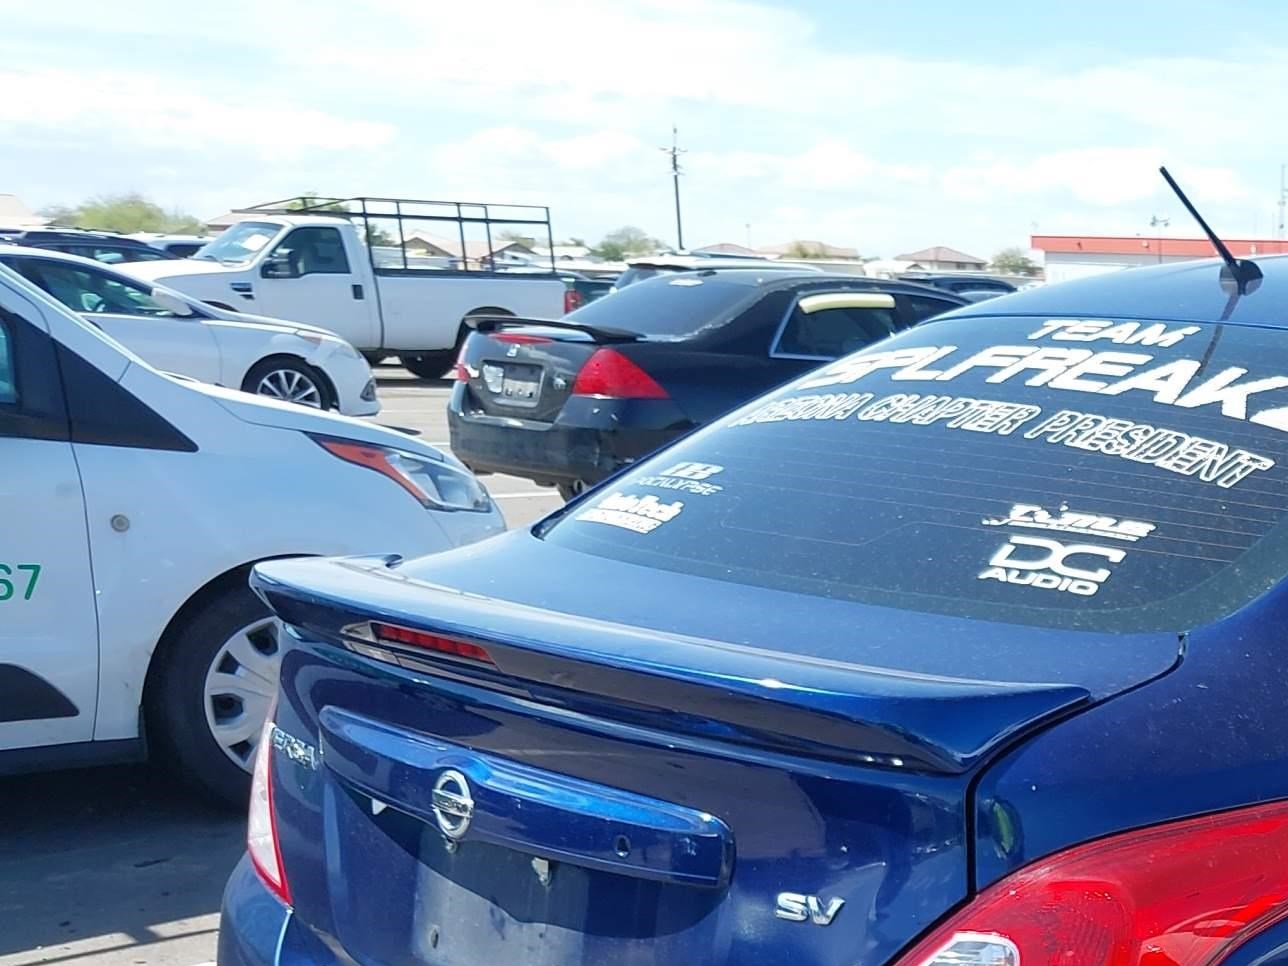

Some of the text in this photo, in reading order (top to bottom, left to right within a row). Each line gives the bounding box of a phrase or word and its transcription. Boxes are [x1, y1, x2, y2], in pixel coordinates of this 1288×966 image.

[1027, 320, 1201, 348] TEAM
[858, 394, 1042, 436] CHAPTER
[1024, 410, 1276, 488] PRESIDENT
[989, 535, 1128, 583] DC
[977, 567, 1099, 596] AUDIO
[775, 892, 846, 925] SV
